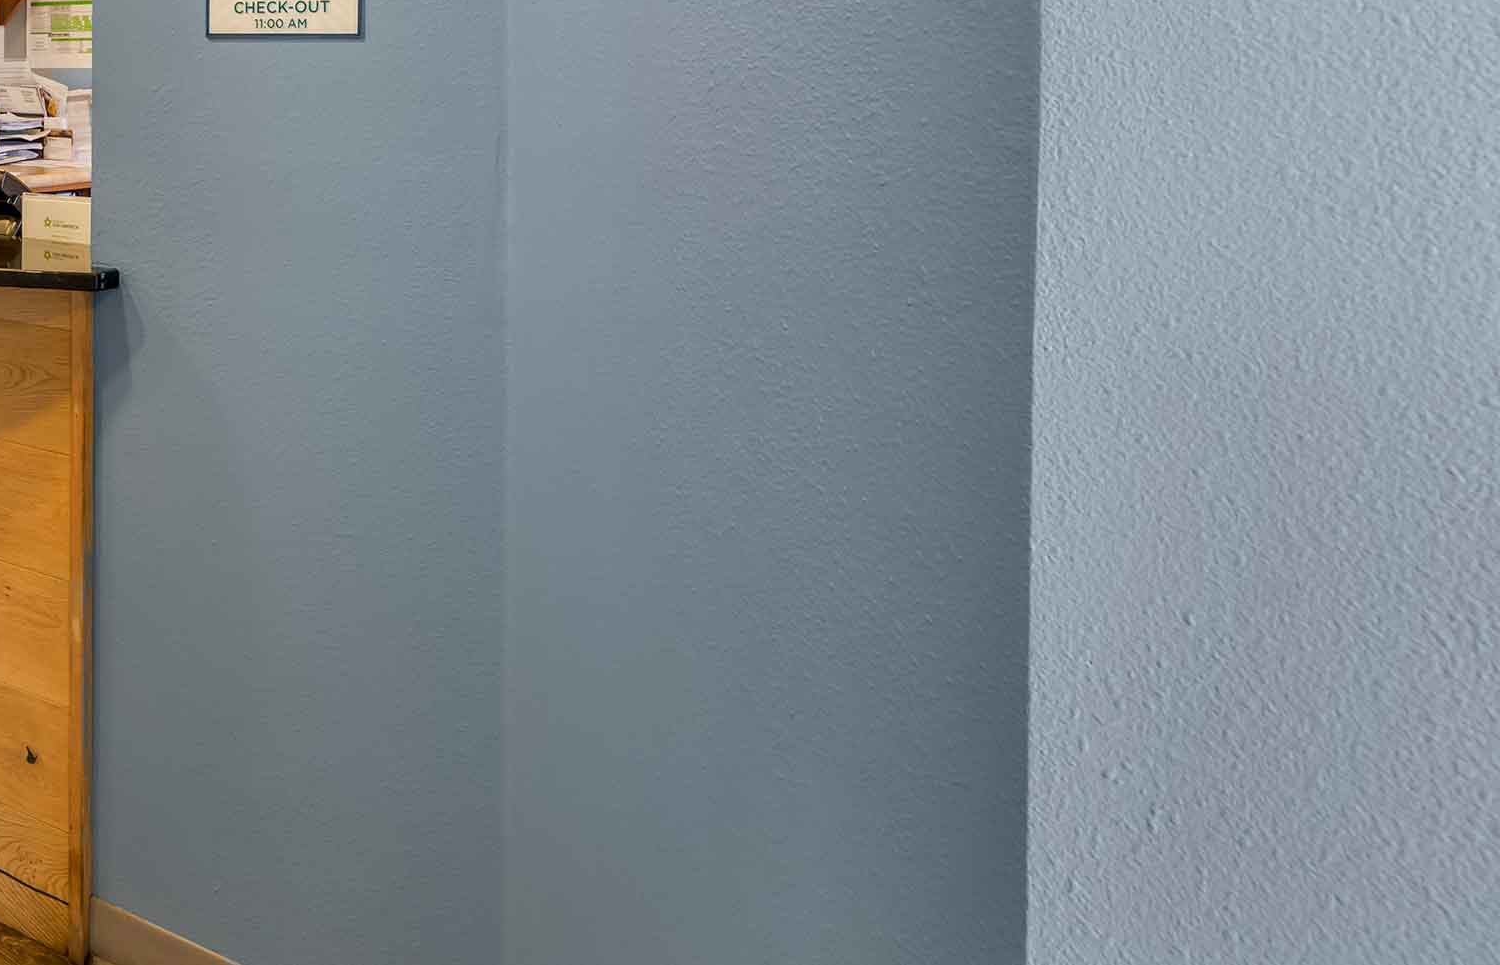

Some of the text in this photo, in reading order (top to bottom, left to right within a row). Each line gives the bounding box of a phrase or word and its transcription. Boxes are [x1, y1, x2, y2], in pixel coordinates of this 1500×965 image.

[234, 0, 331, 14] CHECK-OUT
[254, 18, 308, 29] 11:00 AM
